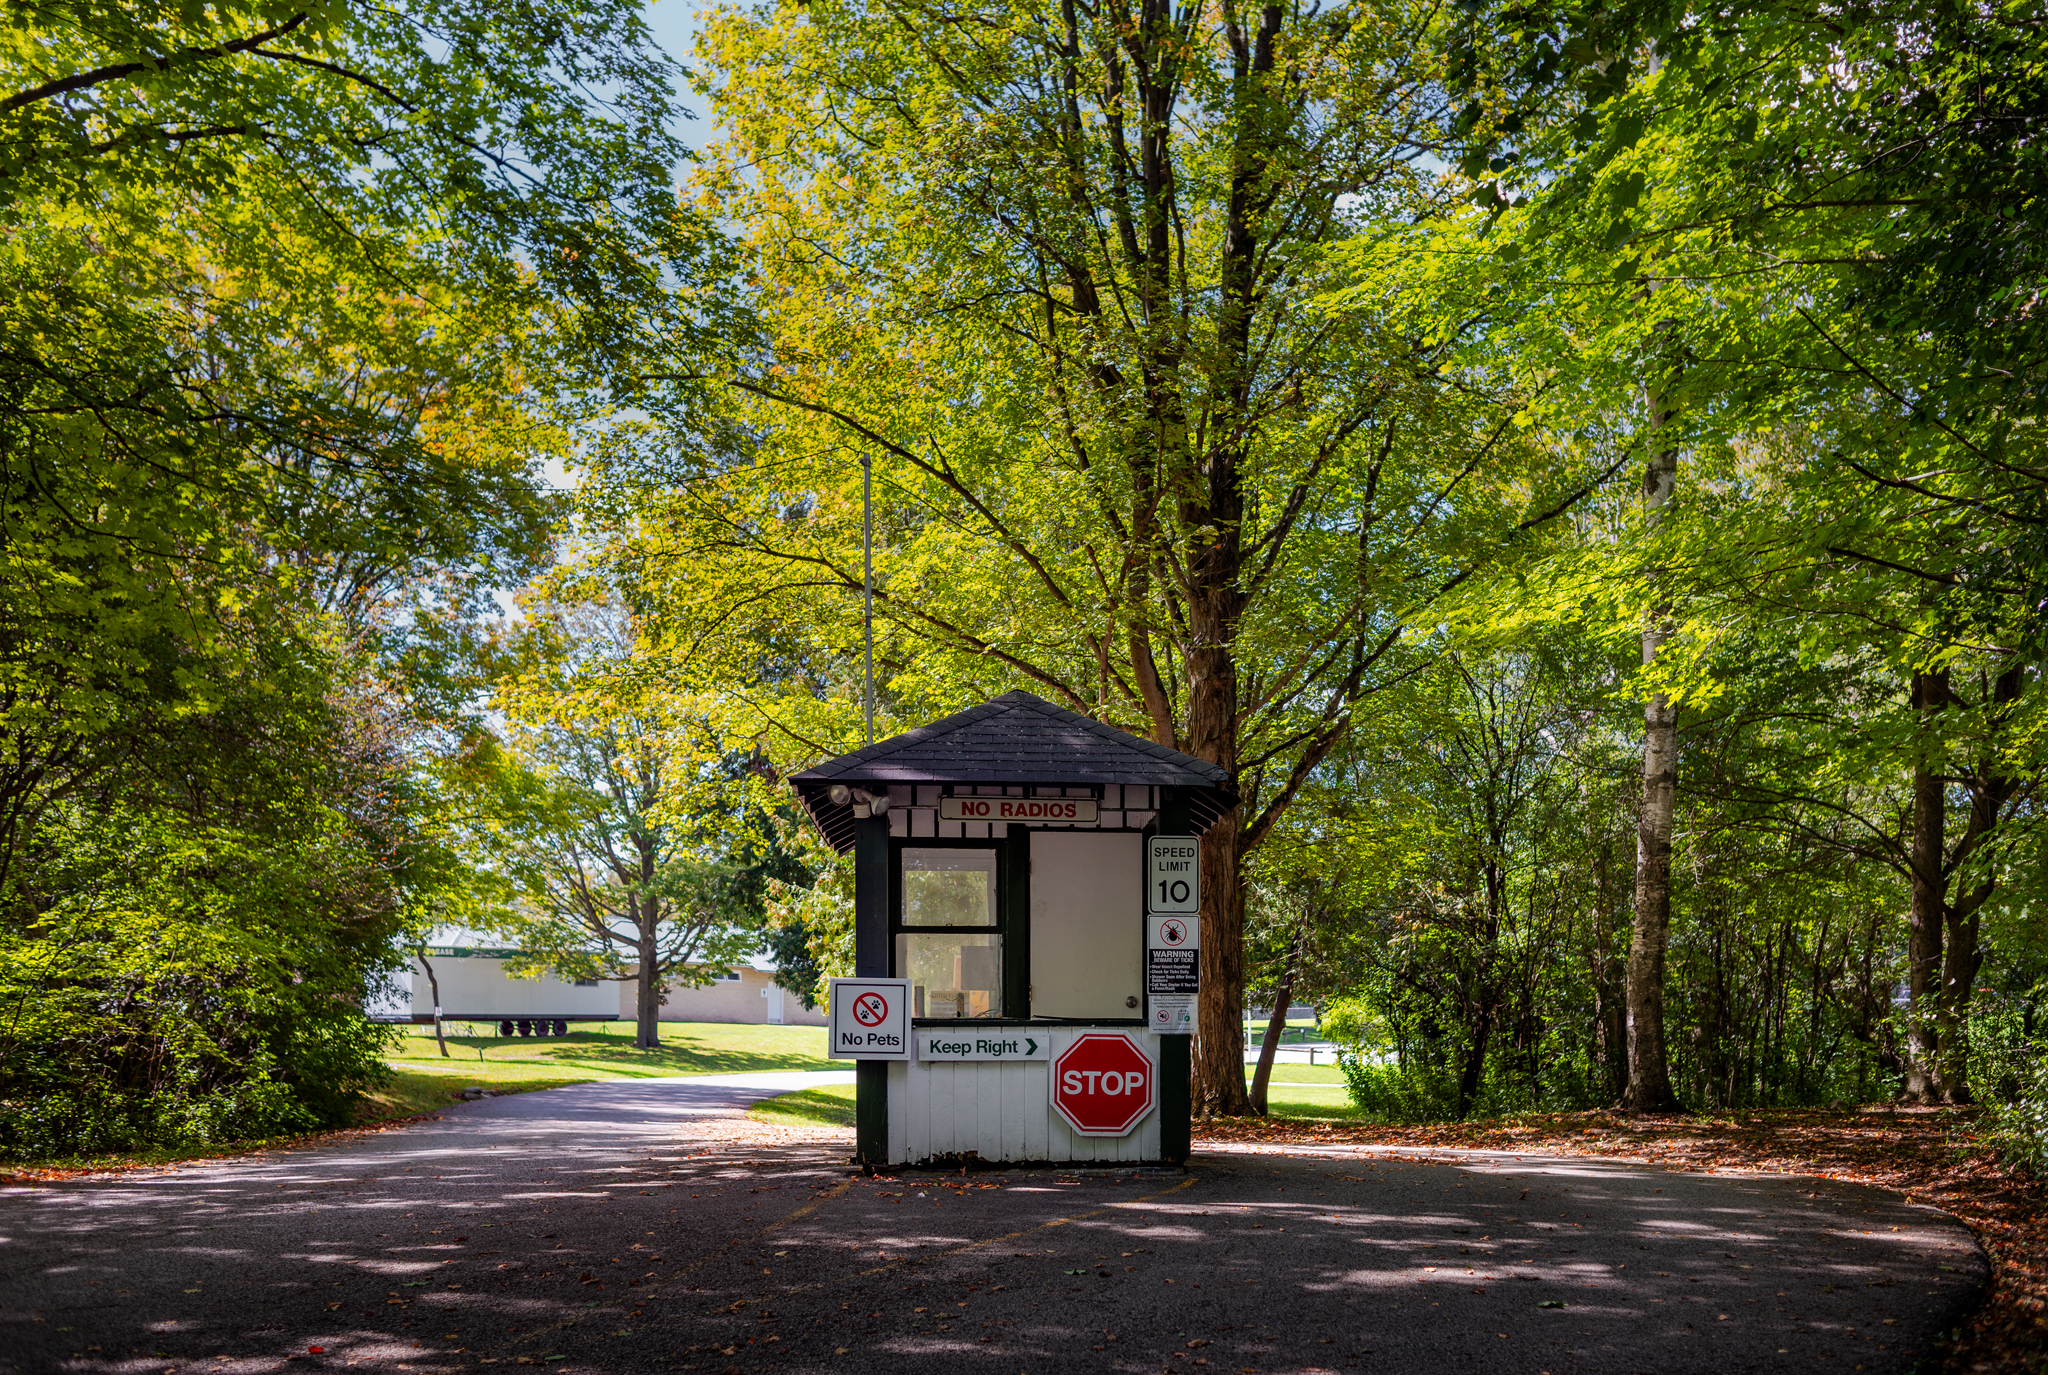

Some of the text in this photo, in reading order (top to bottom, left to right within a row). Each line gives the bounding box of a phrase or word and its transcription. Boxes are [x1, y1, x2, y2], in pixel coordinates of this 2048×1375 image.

[961, 801, 1077, 818] NO RADIOS
[1154, 847, 1195, 858] SPEED
[1159, 861, 1191, 871] LIMIT
[1158, 879, 1190, 904] 10
[842, 1032, 900, 1046] No Pets
[930, 1040, 1018, 1056] Keep Right
[1062, 1070, 1144, 1096] STOP
